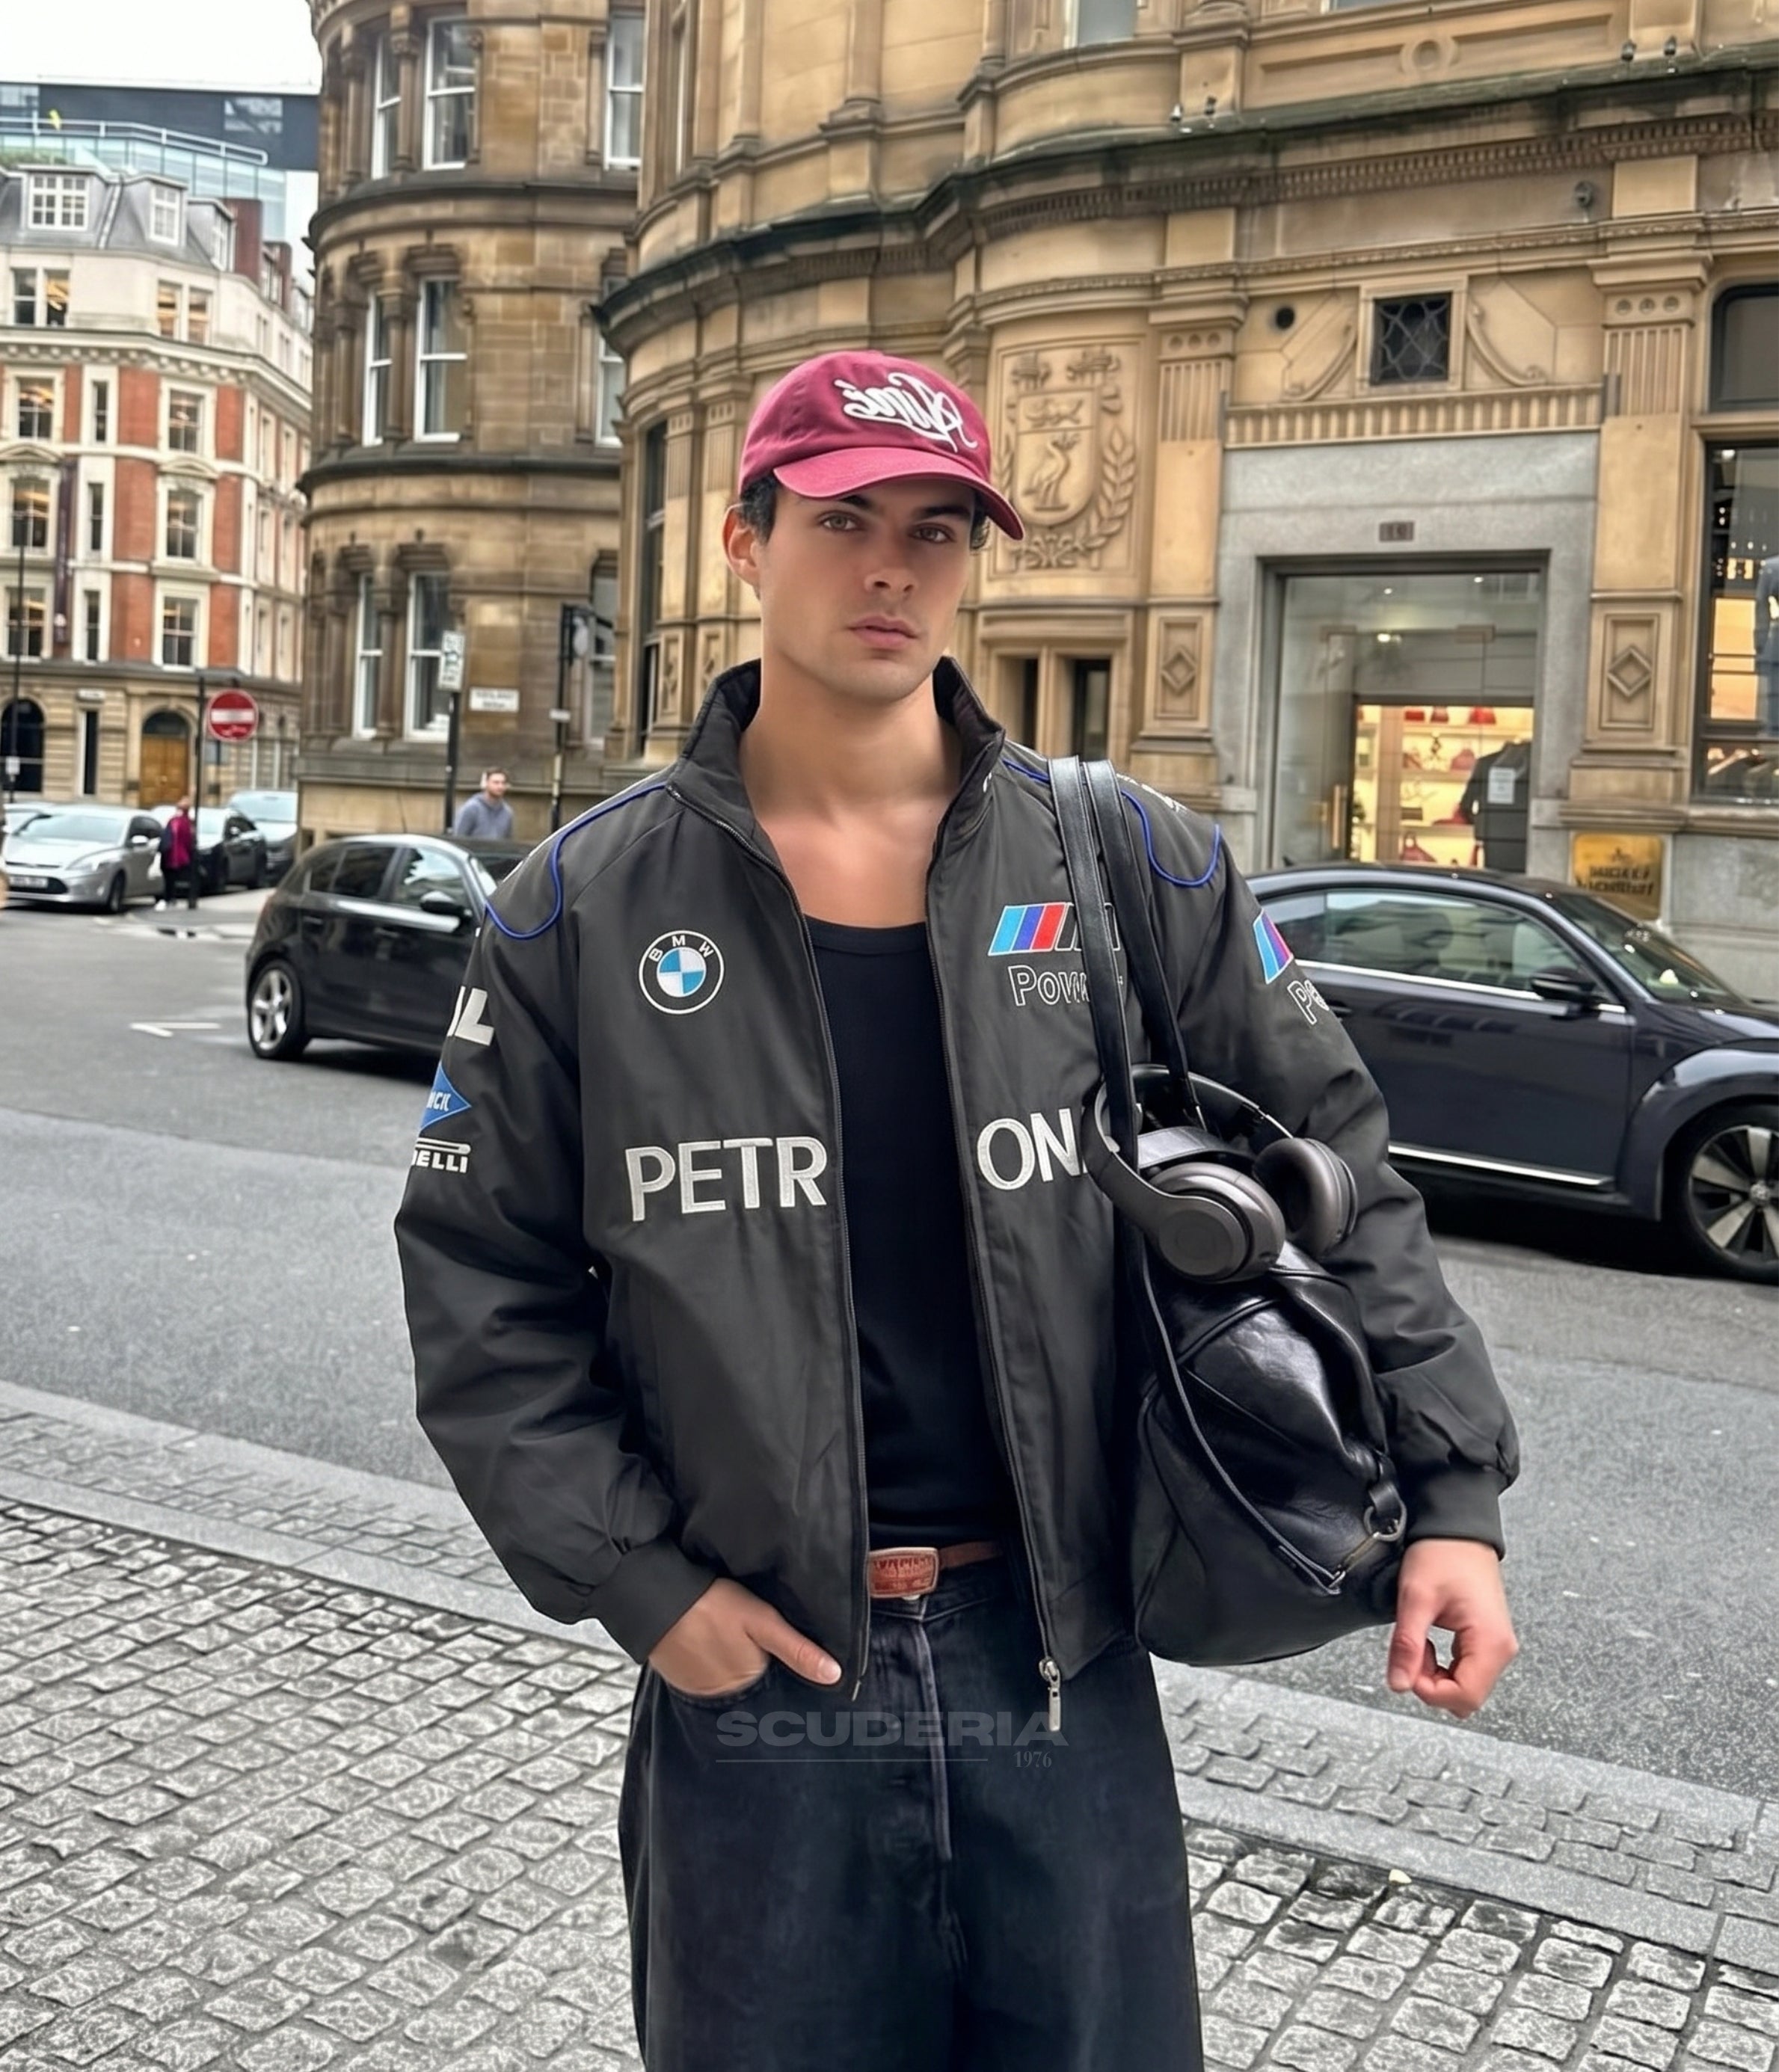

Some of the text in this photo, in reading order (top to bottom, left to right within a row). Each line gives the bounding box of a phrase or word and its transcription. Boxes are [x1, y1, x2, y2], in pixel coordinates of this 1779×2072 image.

[648, 935, 714, 962] BMW
[625, 1108, 1088, 1221] PETR ON
